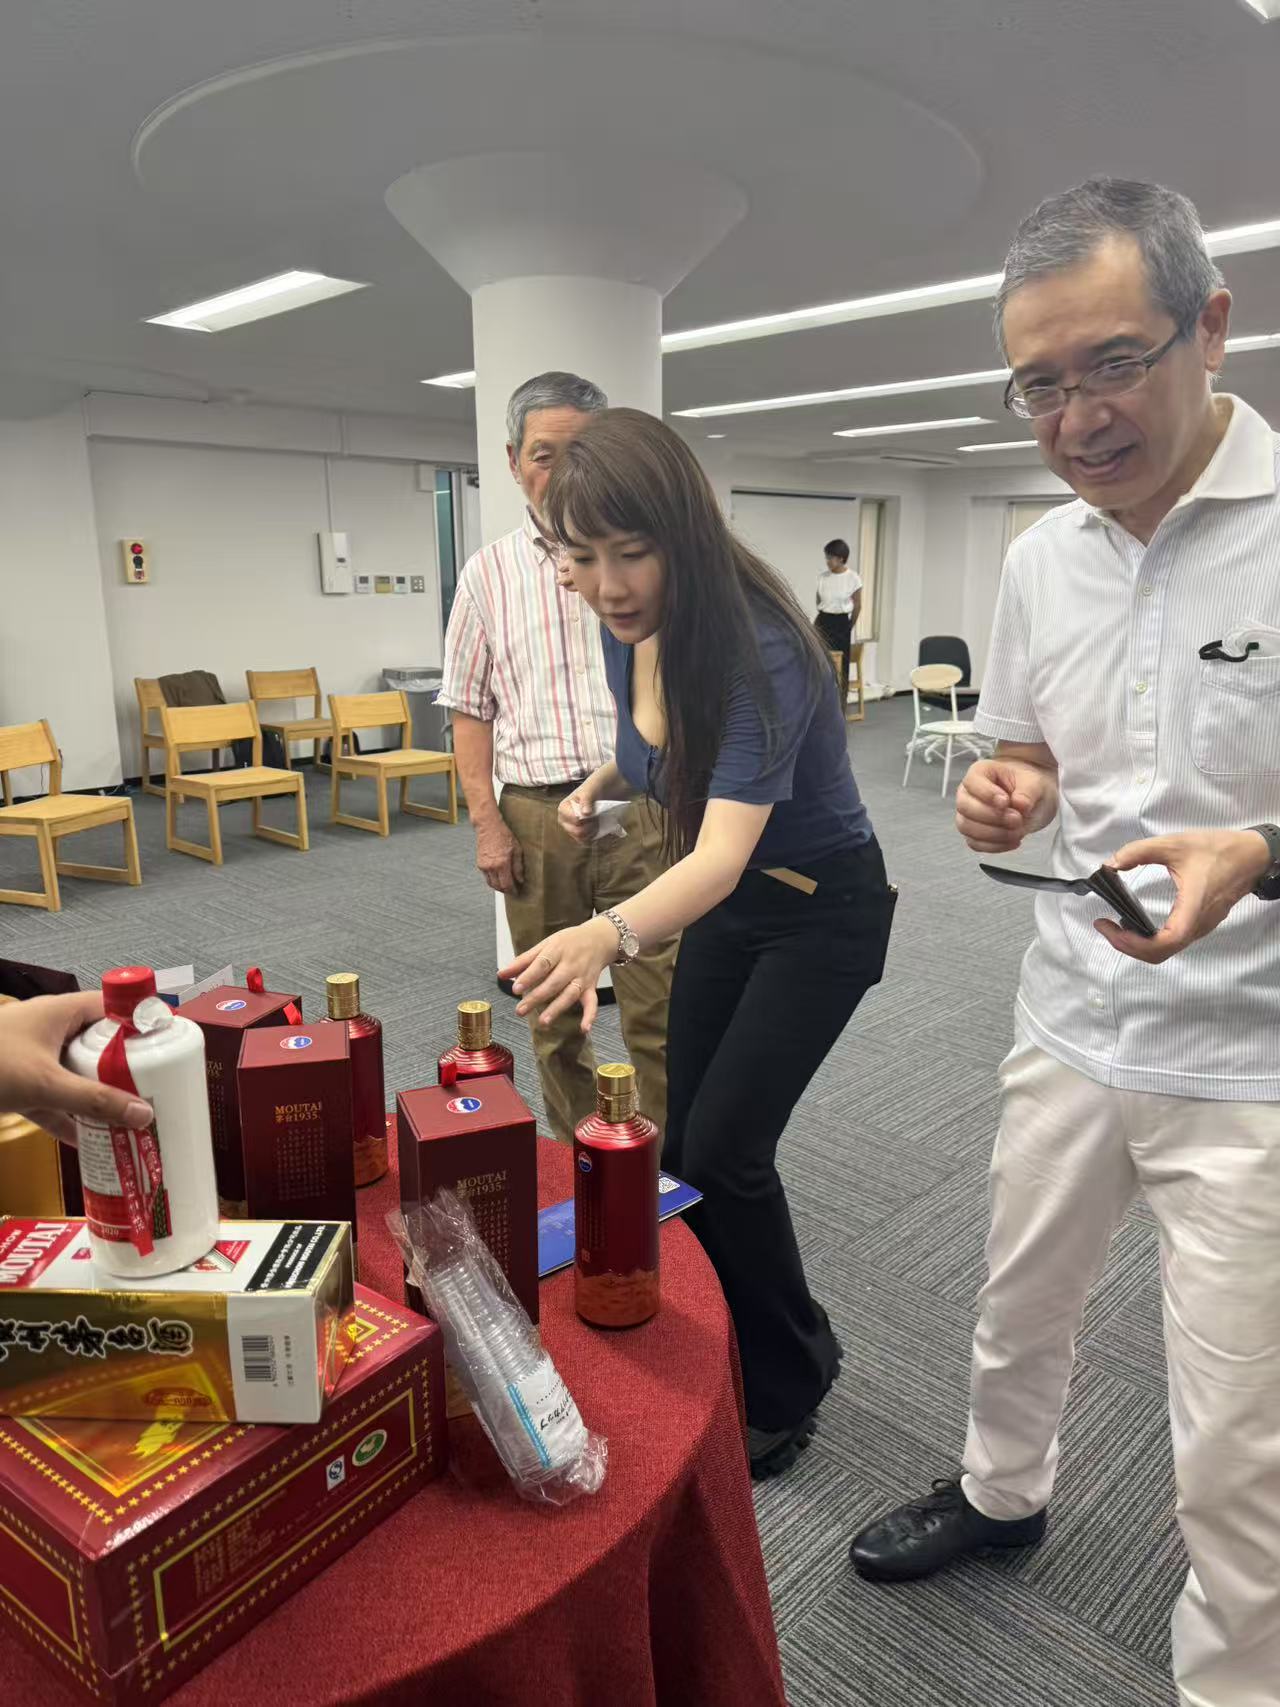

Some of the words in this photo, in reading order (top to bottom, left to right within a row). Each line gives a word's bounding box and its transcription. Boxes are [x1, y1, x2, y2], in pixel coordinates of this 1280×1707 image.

[275, 1102, 322, 1114] MOUTAI
[456, 1170, 506, 1190] MOUTAI
[0, 1223, 69, 1284] MOUTAI
